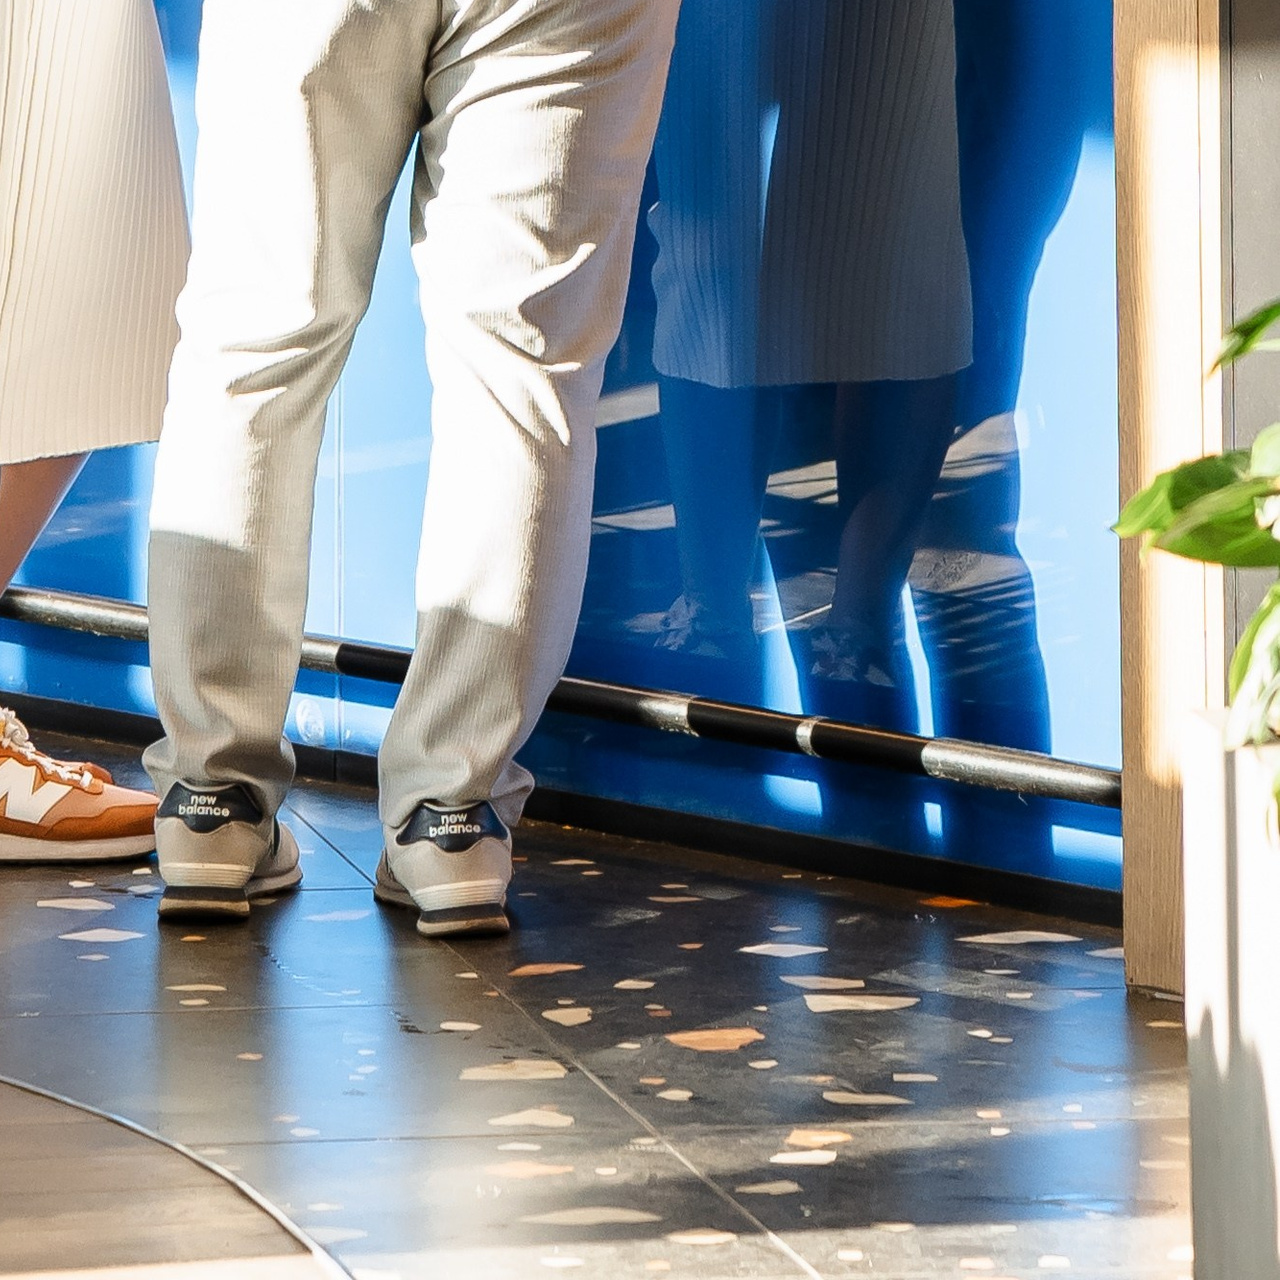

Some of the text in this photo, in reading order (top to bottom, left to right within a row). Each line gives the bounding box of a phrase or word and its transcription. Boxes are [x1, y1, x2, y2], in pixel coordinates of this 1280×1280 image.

[190, 795, 217, 805] new
[178, 804, 231, 817] balance
[440, 813, 468, 825] new
[428, 824, 482, 838] balance
